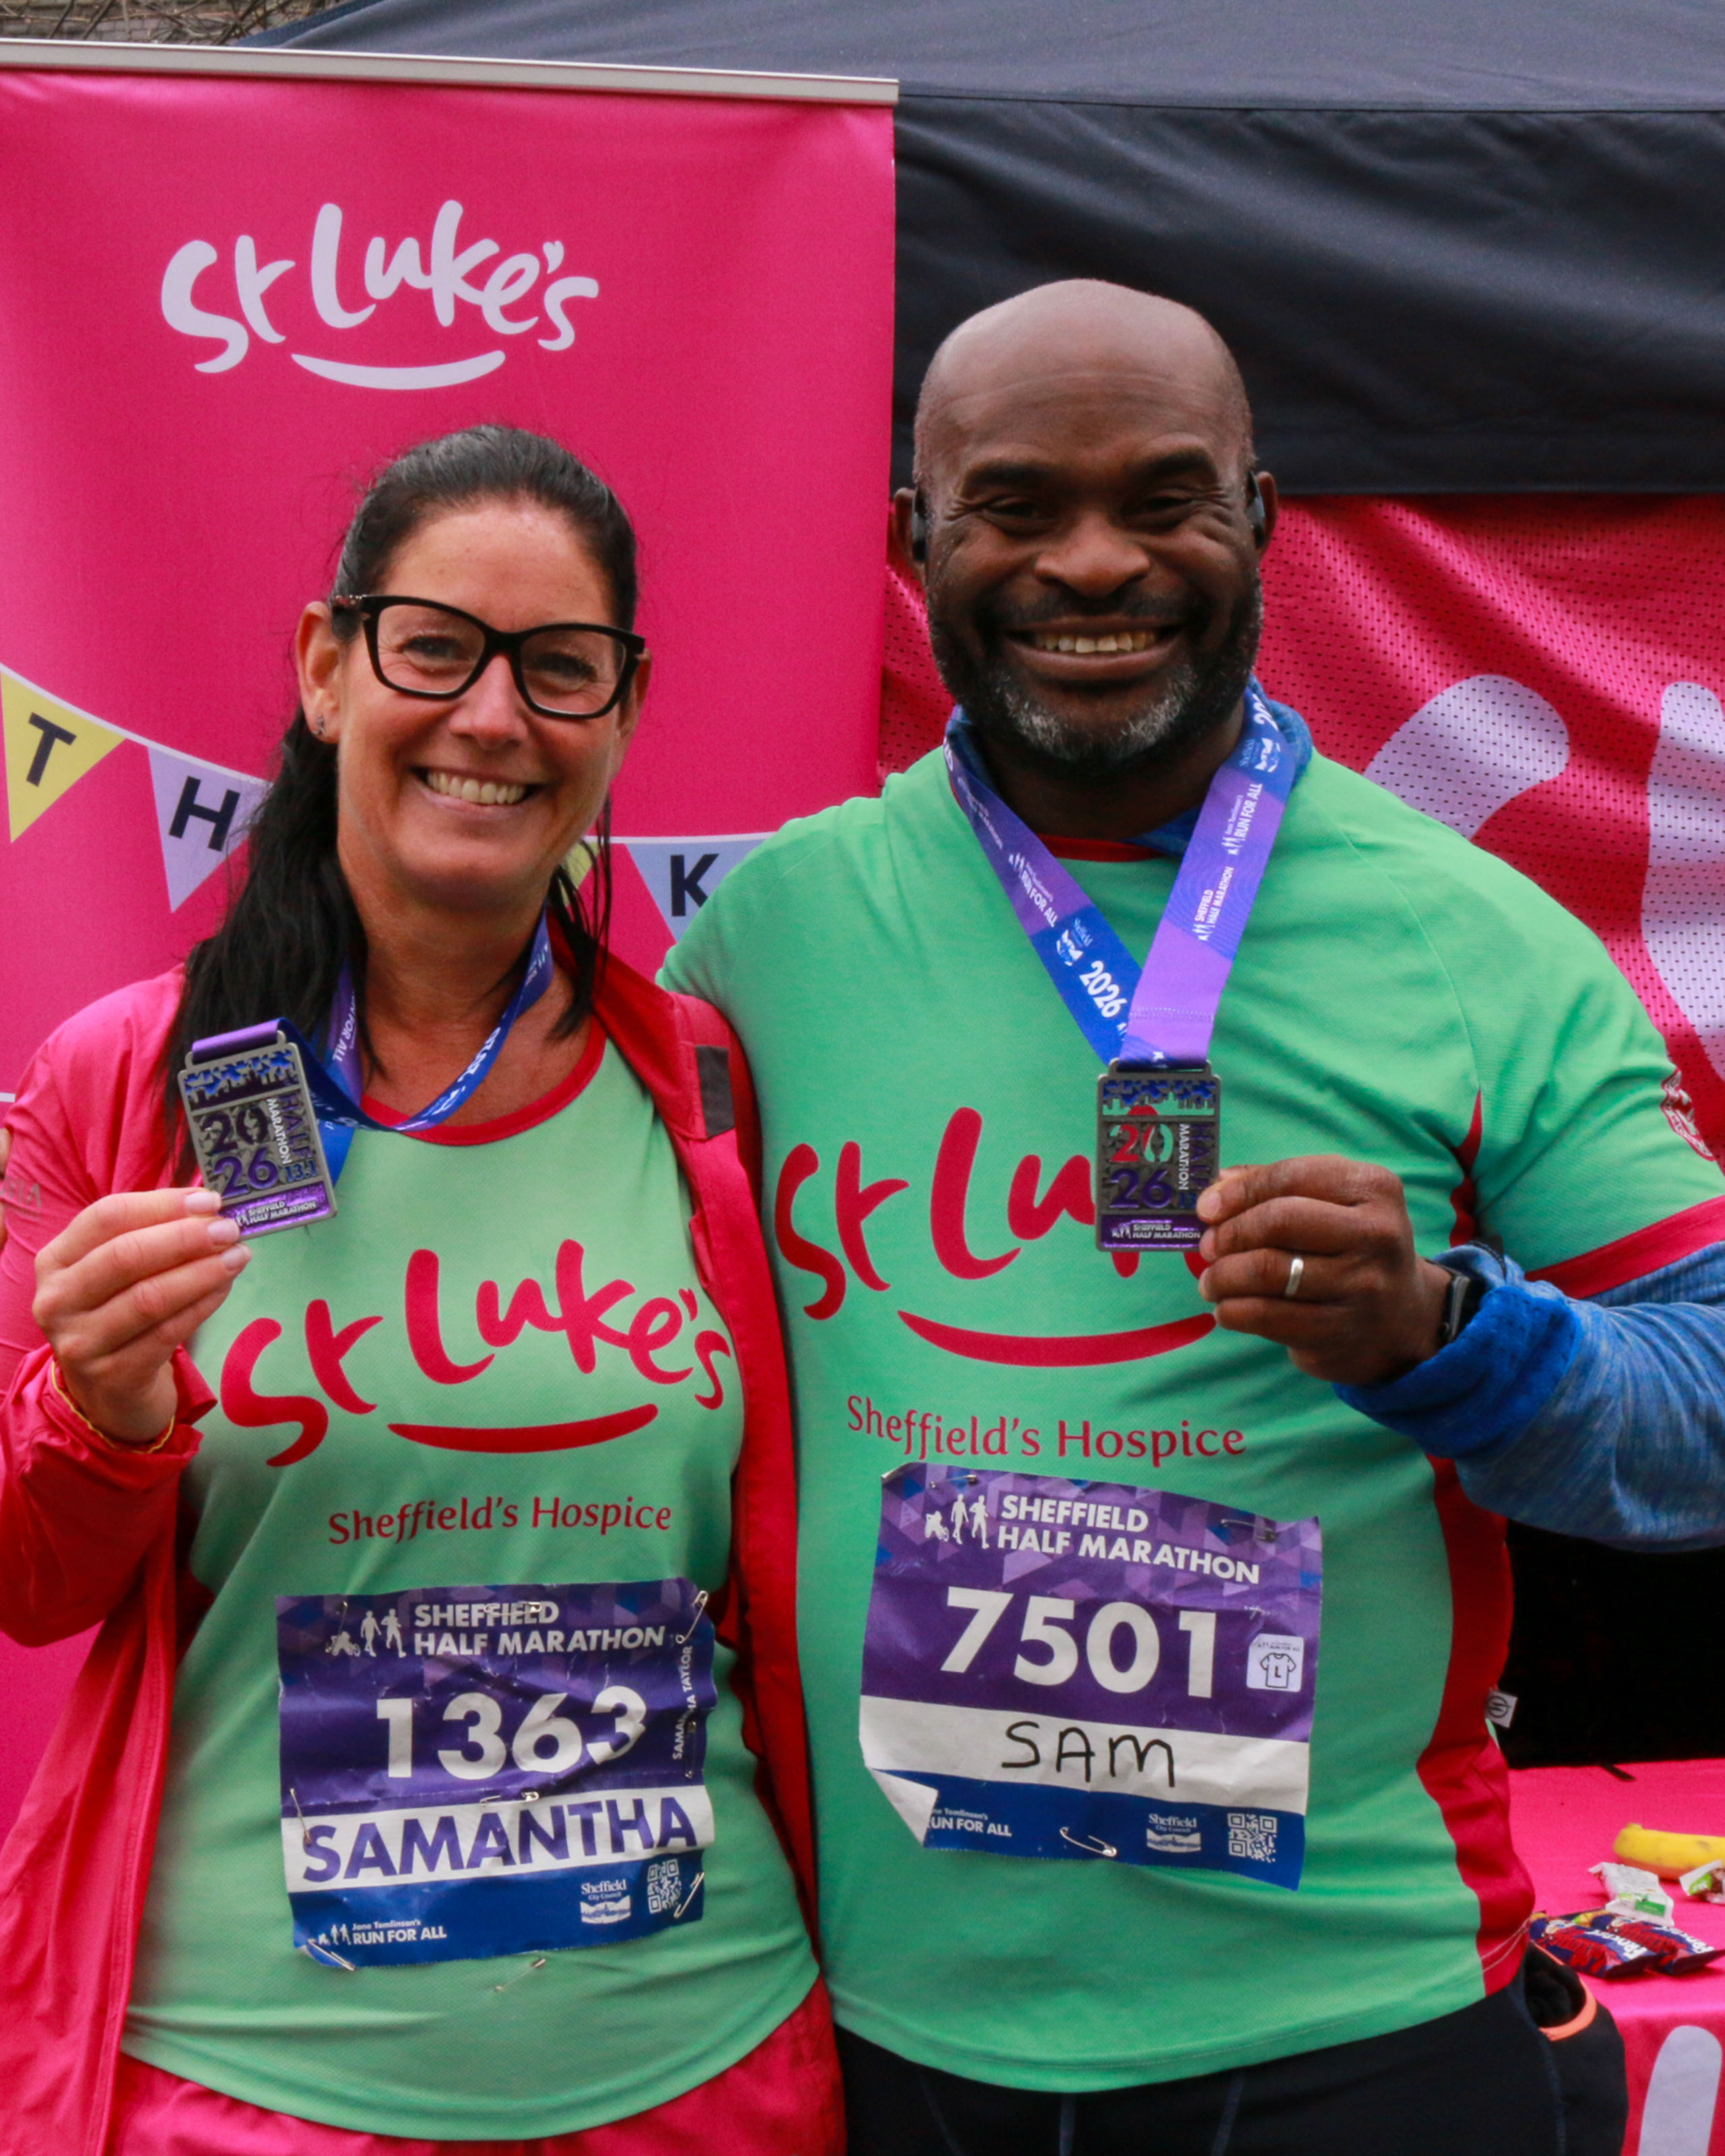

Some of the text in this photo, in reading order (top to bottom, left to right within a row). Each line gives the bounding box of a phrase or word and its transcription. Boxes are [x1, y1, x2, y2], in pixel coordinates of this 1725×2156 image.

[161, 200, 600, 374] St Luke's
[26, 711, 720, 916] T H K
[1241, 799, 1257, 818] FOR
[1247, 783, 1263, 800] ALL
[1030, 888, 1048, 912] FOR
[1044, 906, 1058, 928] ALL
[1213, 866, 1234, 907] MARATHON
[1079, 960, 1127, 1018] 2026
[202, 1104, 268, 1157] 20
[266, 1098, 292, 1165] MARATHON
[1109, 1124, 1173, 1163] 20
[213, 1147, 279, 1199] 26
[1179, 1123, 1191, 1191] MARATHON
[270, 1201, 317, 1218] MARATHON
[1109, 1168, 1172, 1209] 26
[775, 1141, 910, 1321] St
[1133, 1224, 1172, 1232] SHEFFIELD
[220, 1238, 731, 1467] St Luke's
[847, 1395, 1247, 1467] Sheffield's Hospice
[328, 1495, 672, 1545] Sheffield's Hospice
[1001, 1495, 1149, 1533] SHEFFIELD
[998, 1525, 1260, 1584] HALF MARATHON
[414, 1600, 559, 1628] SHEFFIELD
[414, 1626, 665, 1655] HALF MARATHON
[940, 1586, 1216, 1699] 7501
[679, 1645, 693, 1692] TAYLOR
[1275, 1666, 1282, 1678] L
[376, 1685, 647, 1780] 1363
[1001, 1721, 1175, 1787] SAM
[303, 1796, 697, 1883] SAMANTHA
[929, 1816, 1012, 1837] UN FOR ALL
[1149, 1813, 1197, 1828] Sheffield
[581, 1879, 627, 1895] Sheffield
[352, 1926, 447, 1944] RUN FOR ALL
[373, 1919, 421, 1929] Tomlinson's
